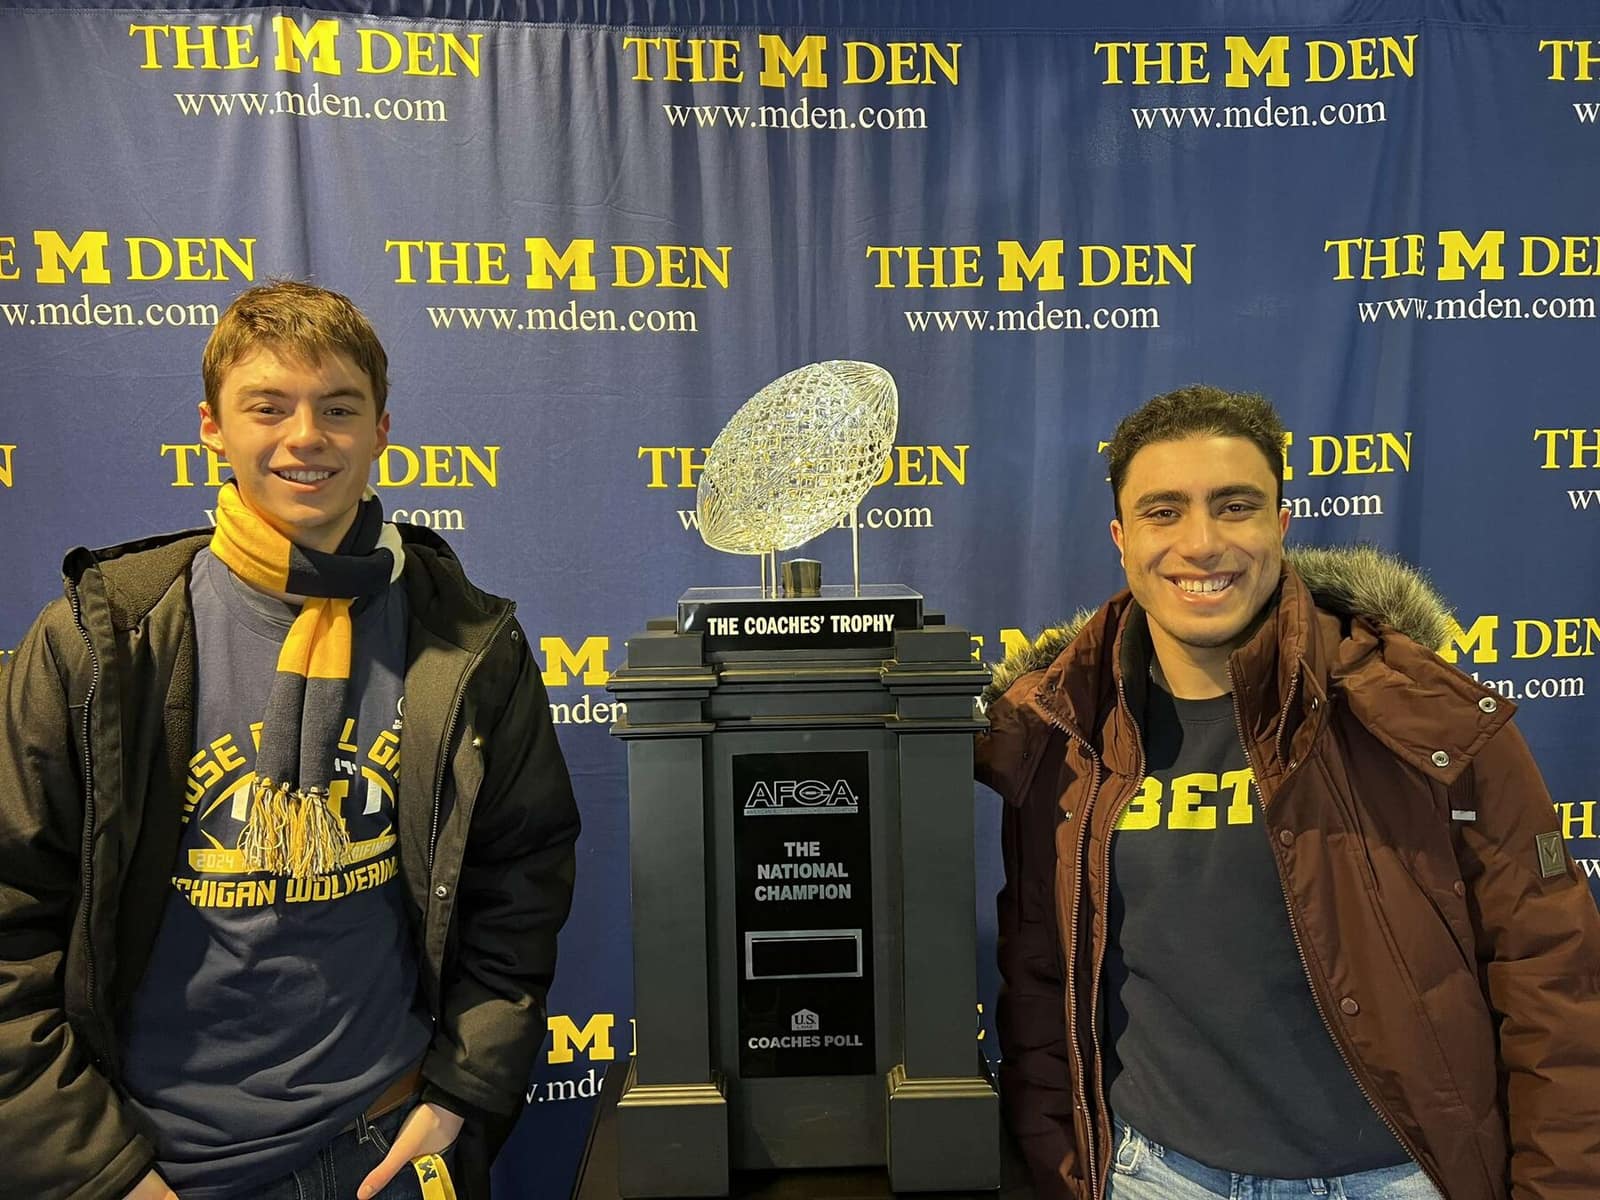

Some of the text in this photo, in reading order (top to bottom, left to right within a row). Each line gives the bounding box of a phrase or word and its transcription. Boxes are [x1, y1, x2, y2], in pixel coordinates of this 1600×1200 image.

[128, 15, 484, 79] THE M DEN
[622, 34, 961, 89] THE M DEN
[1094, 35, 1418, 88] THE M DEN
[173, 82, 449, 123] www.mden.com
[662, 97, 928, 131] www.mden.com
[1131, 96, 1387, 129] www.mden.com
[33, 230, 112, 285] M
[124, 237, 257, 282] DEN
[384, 237, 733, 293] THE M DEN
[866, 239, 1196, 292] THE M DEN
[1324, 234, 1425, 280] THE
[1437, 230, 1505, 281] M
[425, 300, 699, 333] www.mden.com
[903, 301, 1161, 333] www.mden.com
[1358, 289, 1597, 324] www.mden.com
[376, 444, 500, 488] DEN
[1307, 432, 1413, 477] DEN
[707, 614, 895, 636] THE COACHES' TROPHY
[540, 636, 610, 686] M
[744, 779, 858, 808] AFCA
[783, 841, 821, 857] THE
[757, 862, 849, 880] NATIONAL
[754, 884, 852, 901] CHAMPION
[547, 1013, 615, 1065] M
[748, 1035, 863, 1049] COACHES POLL
